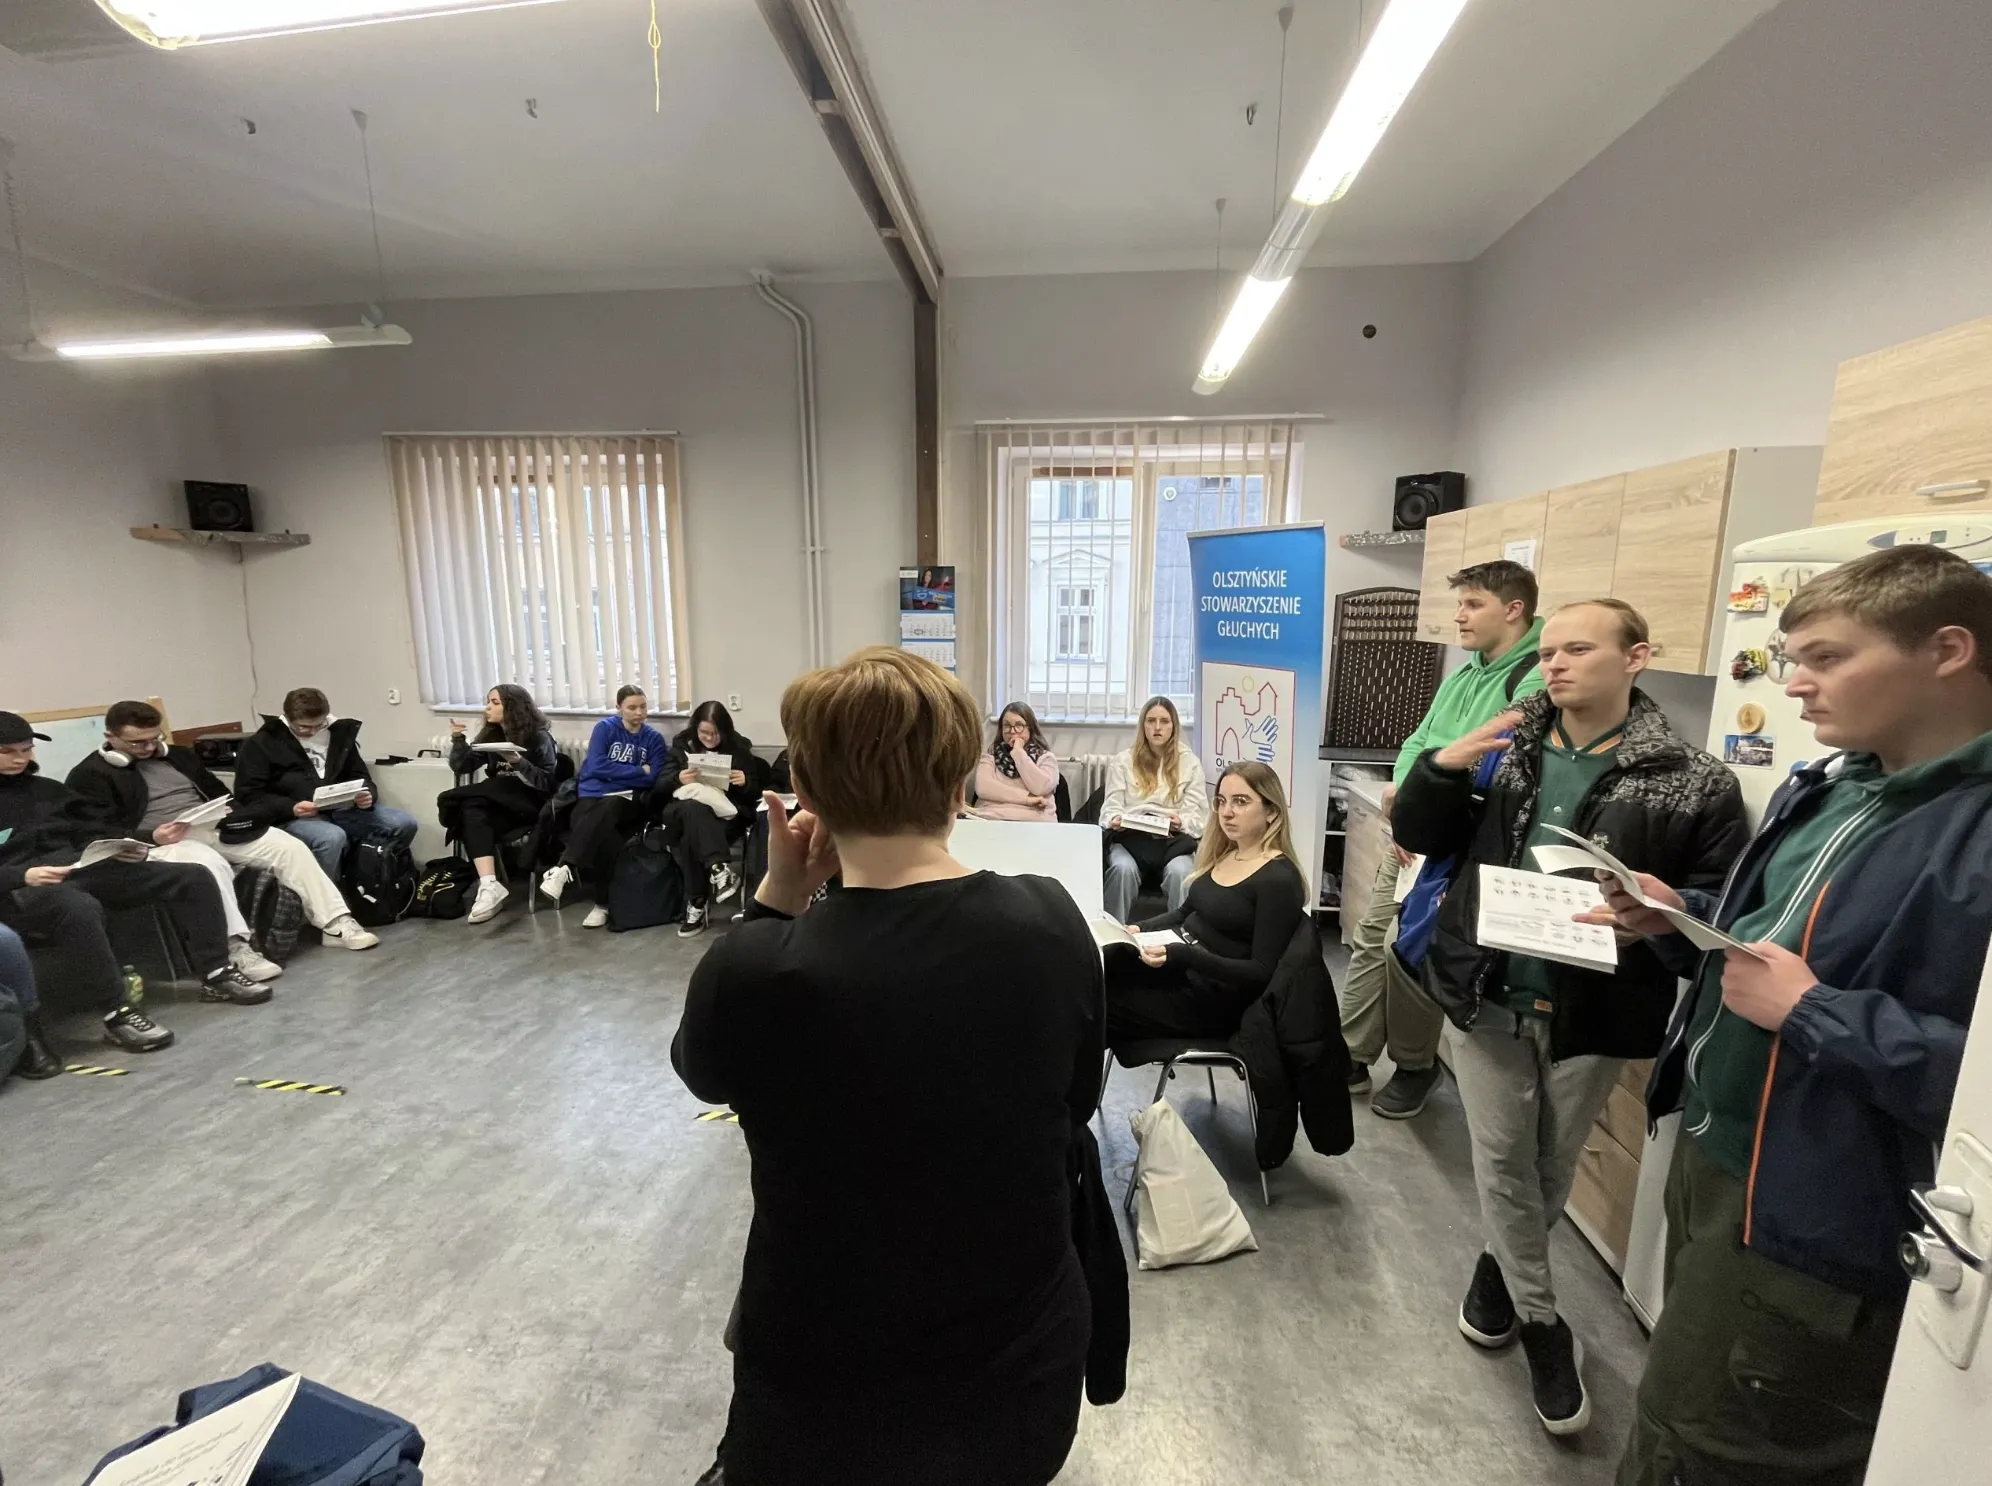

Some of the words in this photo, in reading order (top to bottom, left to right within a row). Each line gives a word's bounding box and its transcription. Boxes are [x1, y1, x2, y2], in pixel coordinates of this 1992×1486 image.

[1212, 566, 1287, 588] OLSZTYŃSKIE
[1200, 595, 1301, 615] STOWARZYSZENIE
[1217, 620, 1279, 640] GŁUCHYCH
